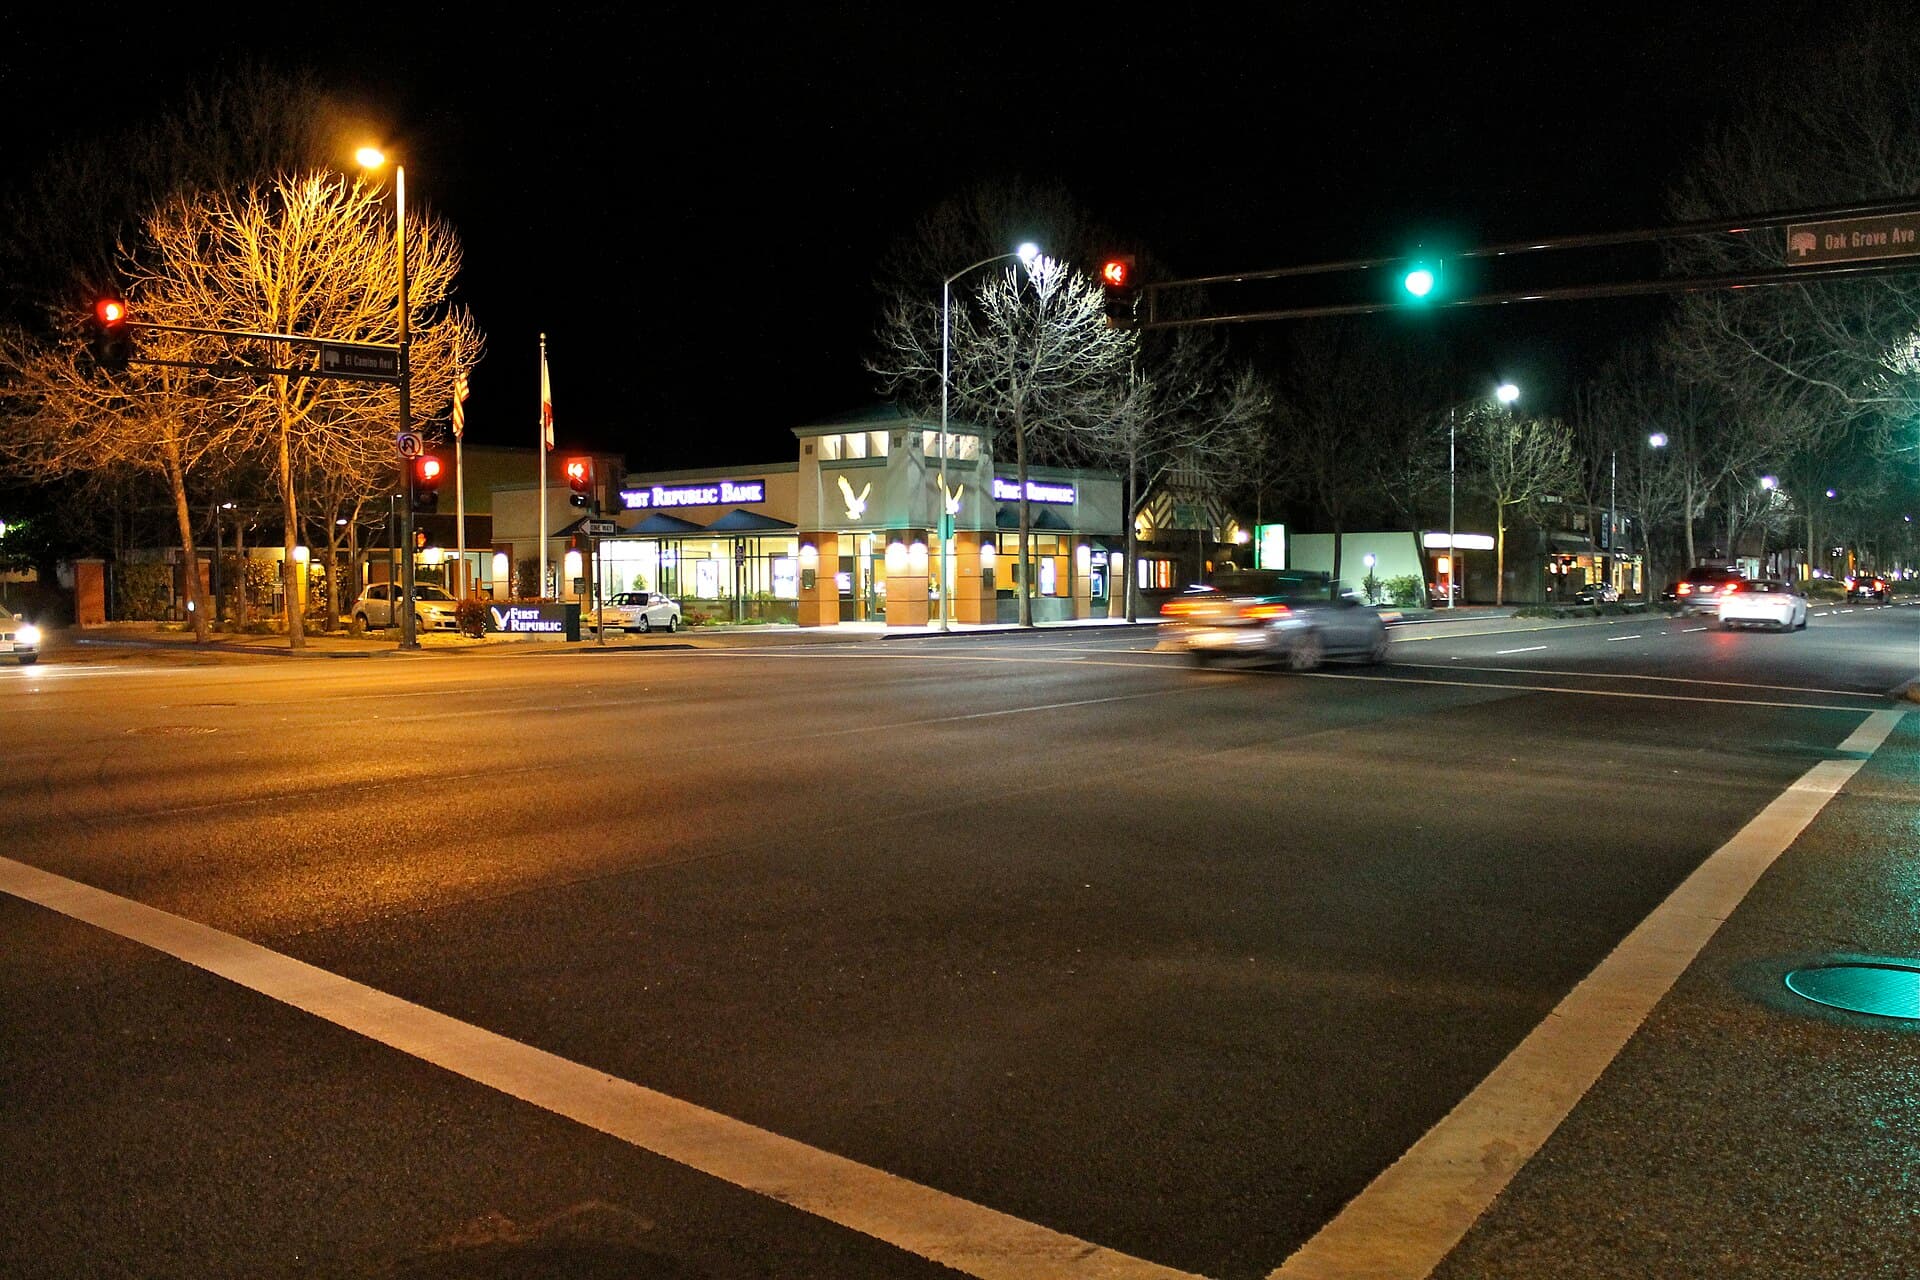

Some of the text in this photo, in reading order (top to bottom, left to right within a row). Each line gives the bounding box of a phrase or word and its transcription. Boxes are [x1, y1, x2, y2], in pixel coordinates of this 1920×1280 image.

[1825, 227, 1915, 250] Oak Grove Ave
[345, 354, 352, 366] El
[354, 355, 378, 368] Camino
[720, 482, 762, 502] BANK
[510, 607, 540, 620] FIRST
[511, 620, 562, 632] REPUBLIC
